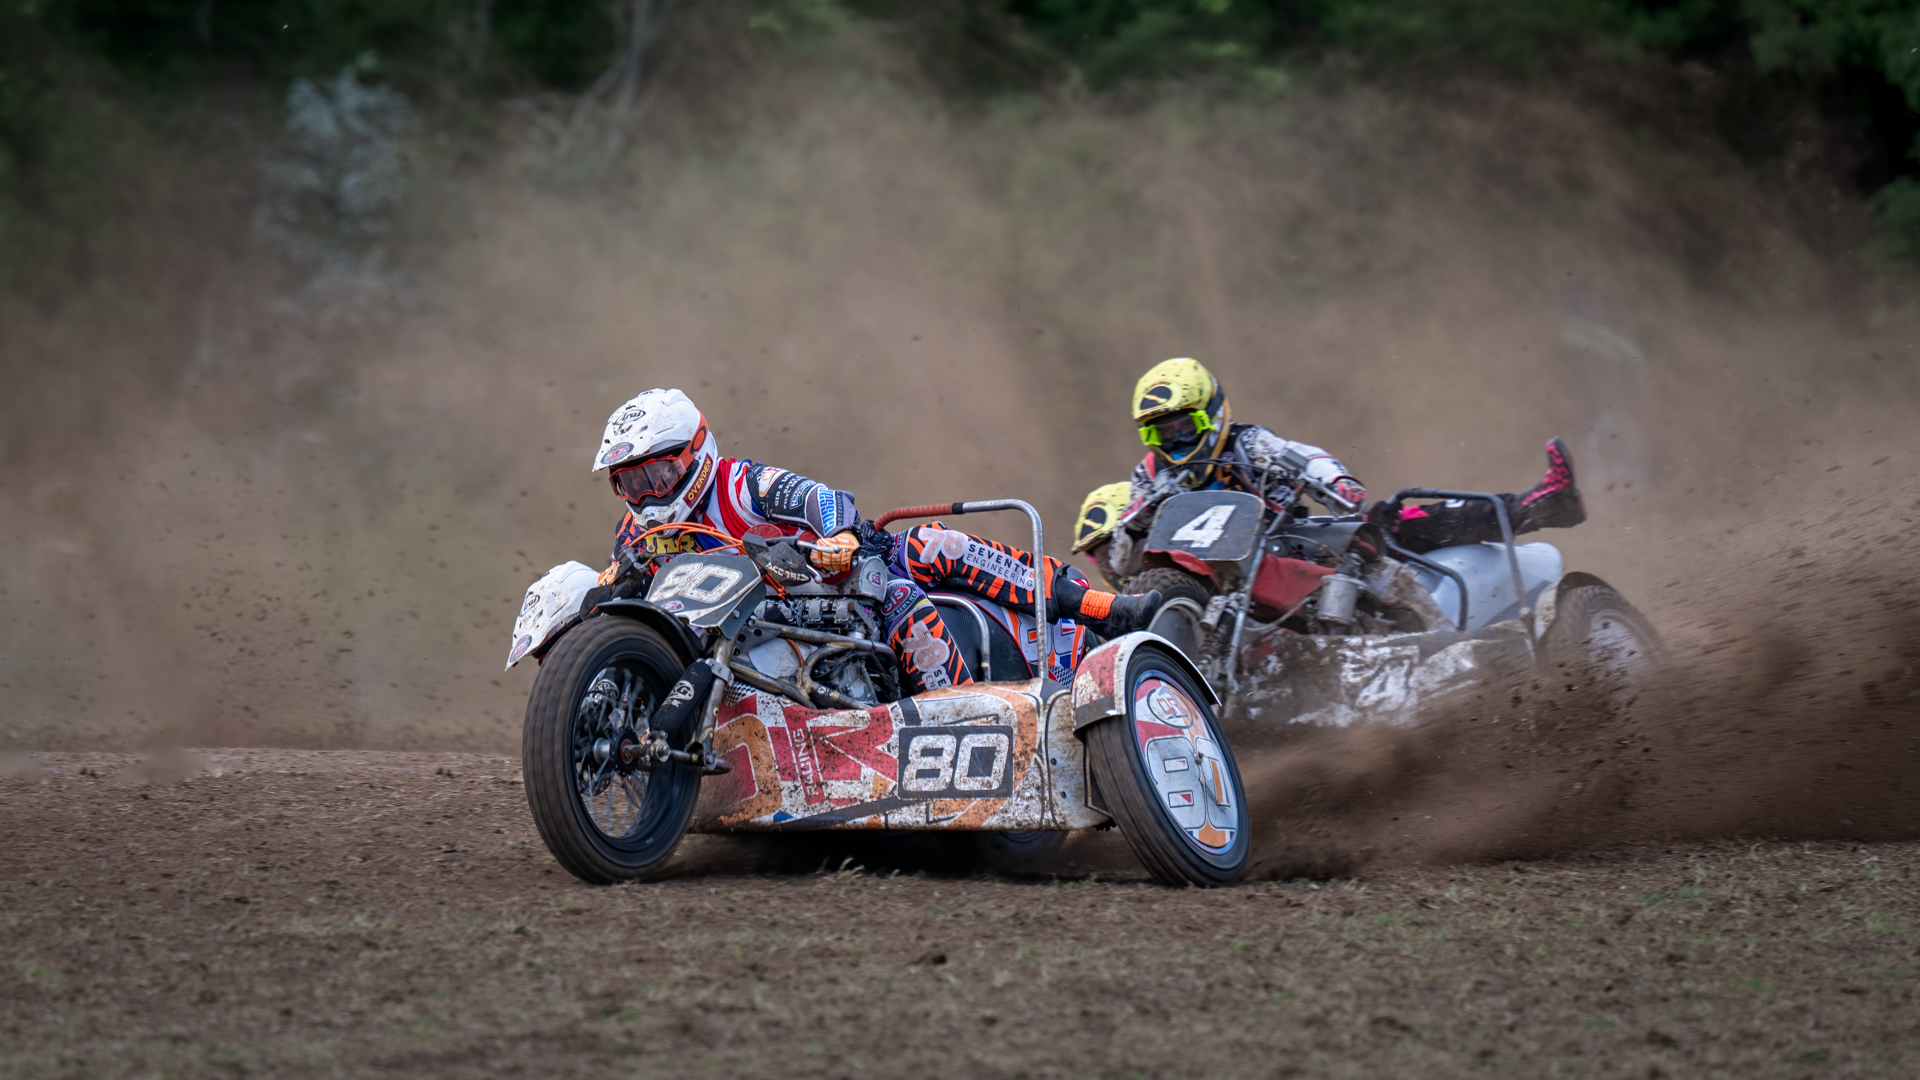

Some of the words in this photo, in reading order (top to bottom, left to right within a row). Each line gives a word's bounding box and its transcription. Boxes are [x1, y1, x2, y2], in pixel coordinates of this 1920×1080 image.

[687, 458, 712, 501] OVENDEN
[1171, 505, 1236, 547] 4
[649, 562, 744, 604] 80
[966, 554, 1034, 588] ENGINEERING
[884, 588, 906, 612] SIS
[902, 733, 1010, 792] 80
